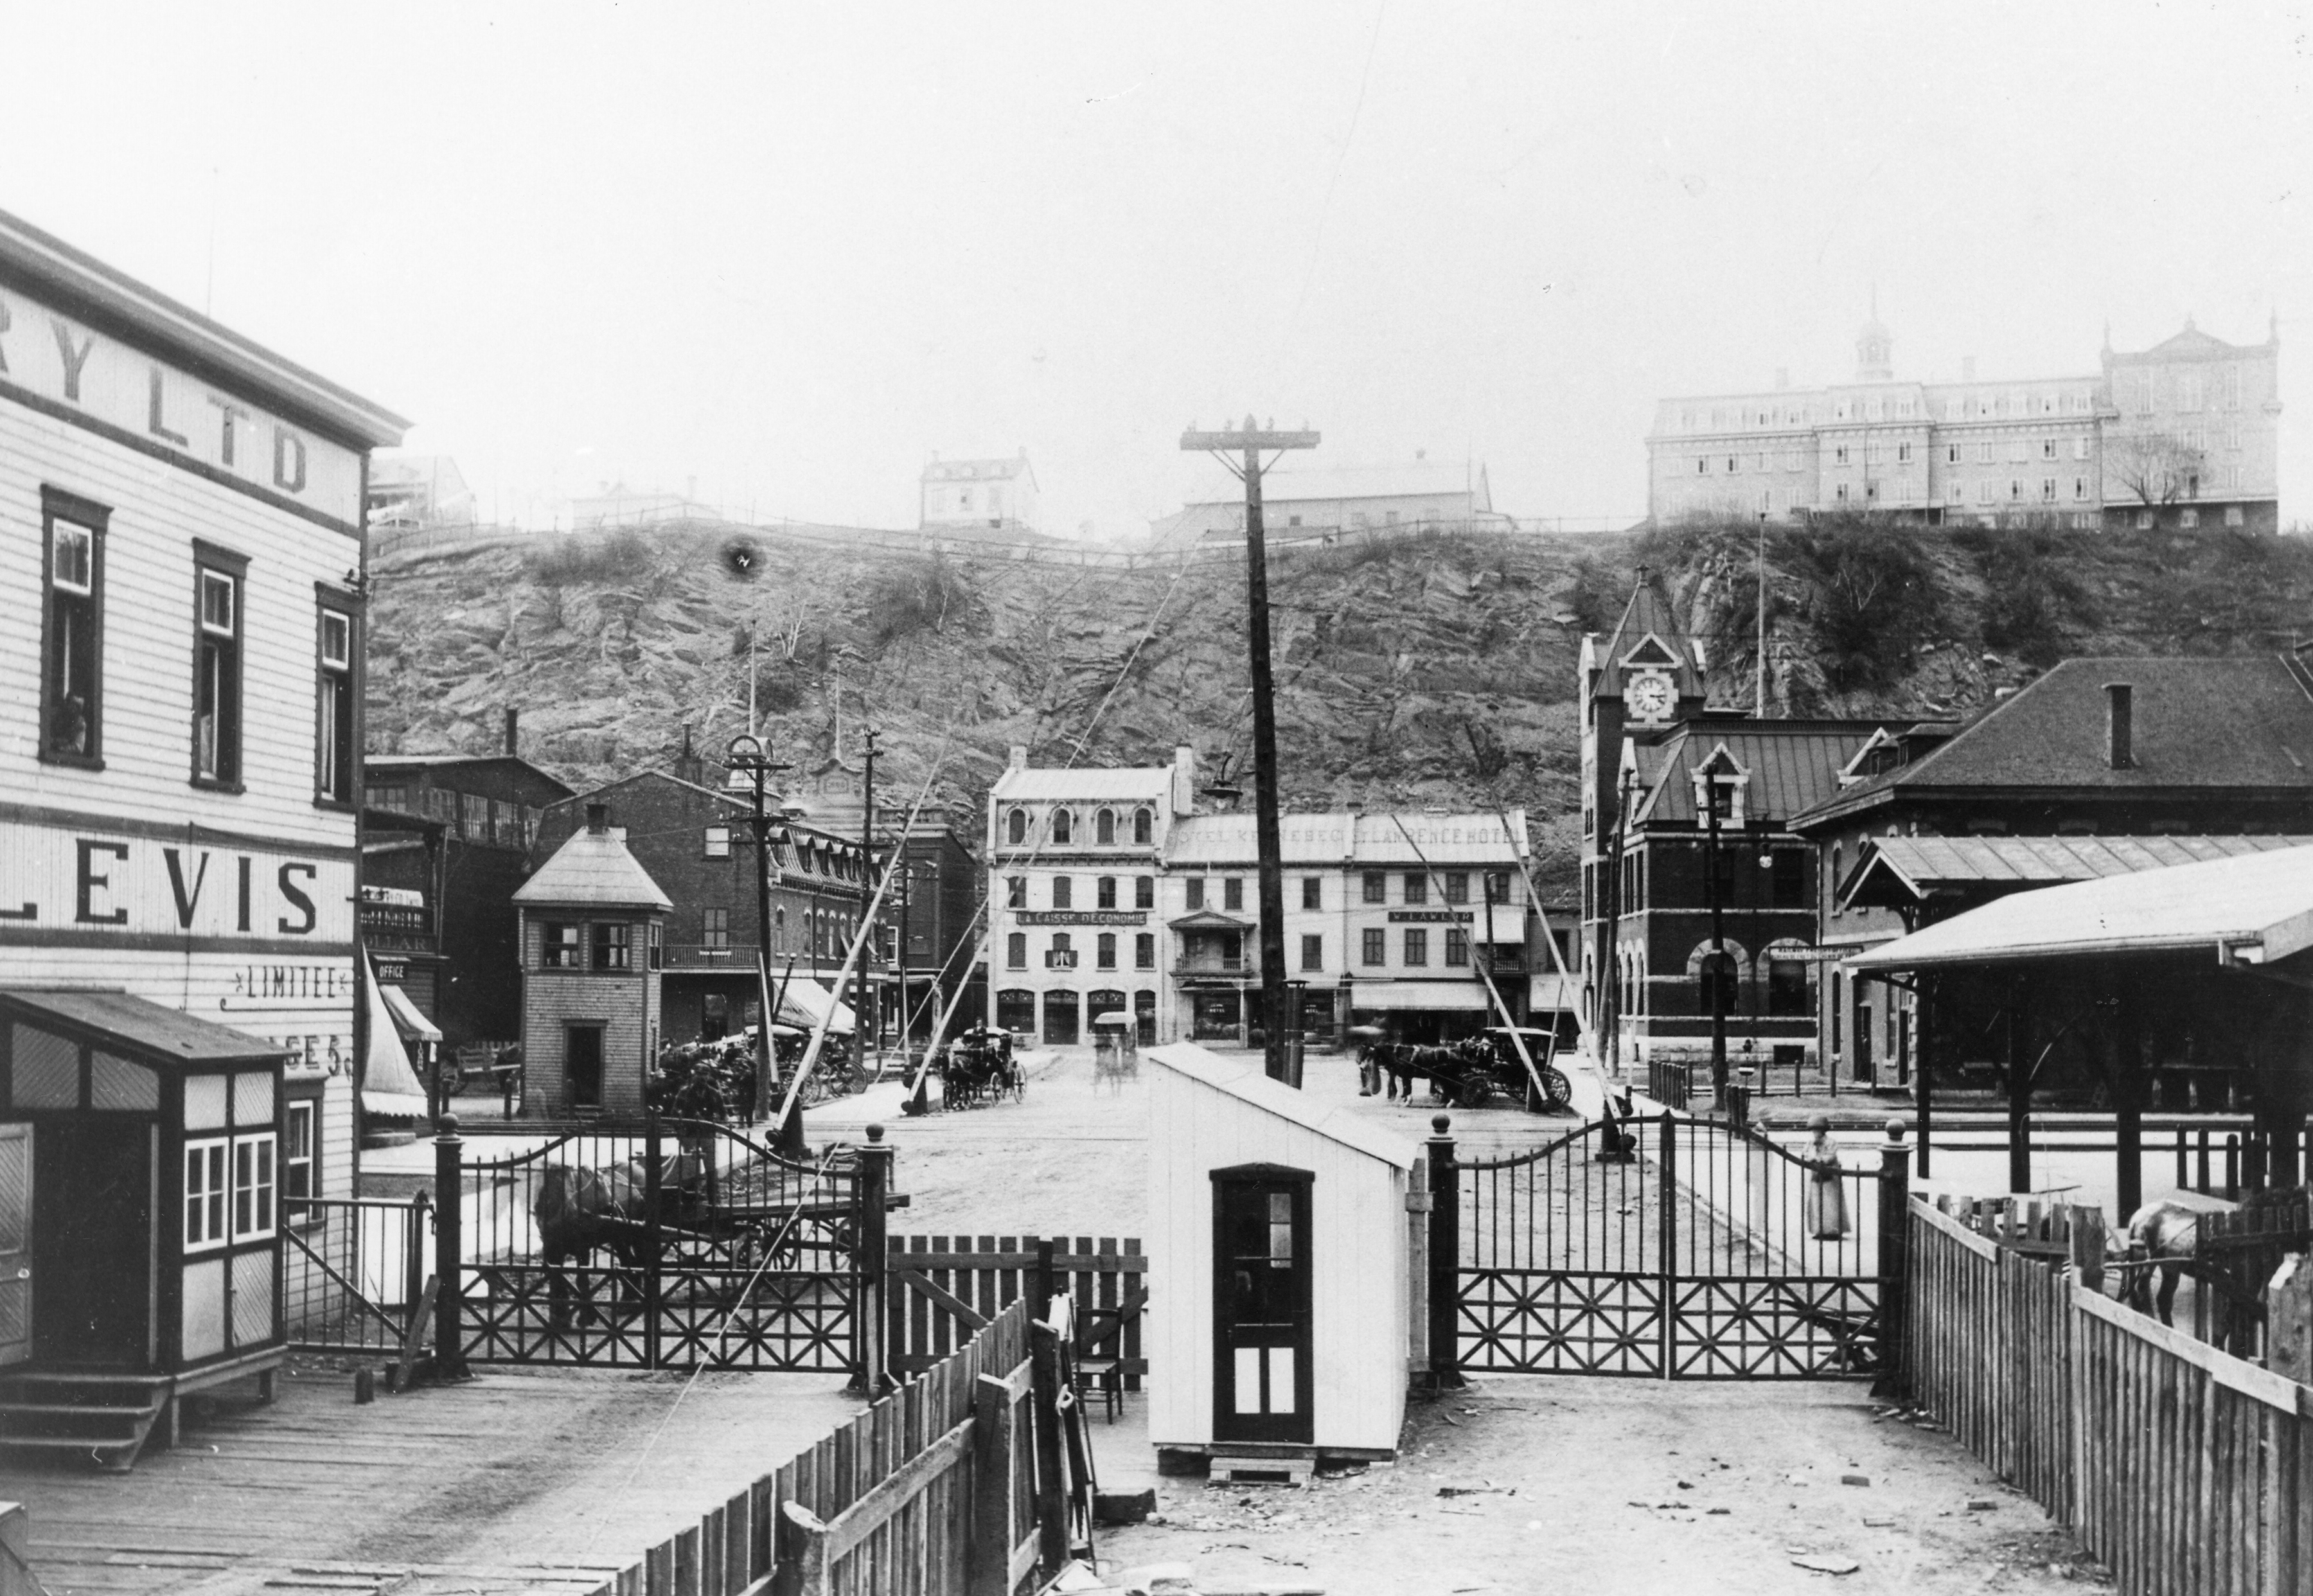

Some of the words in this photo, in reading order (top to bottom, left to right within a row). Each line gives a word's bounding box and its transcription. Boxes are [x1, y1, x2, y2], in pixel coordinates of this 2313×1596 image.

[148, 364, 306, 494] LTD
[1017, 912, 1031, 923] LA
[1035, 912, 1076, 923] CAISSE
[379, 965, 403, 979] OFFICE
